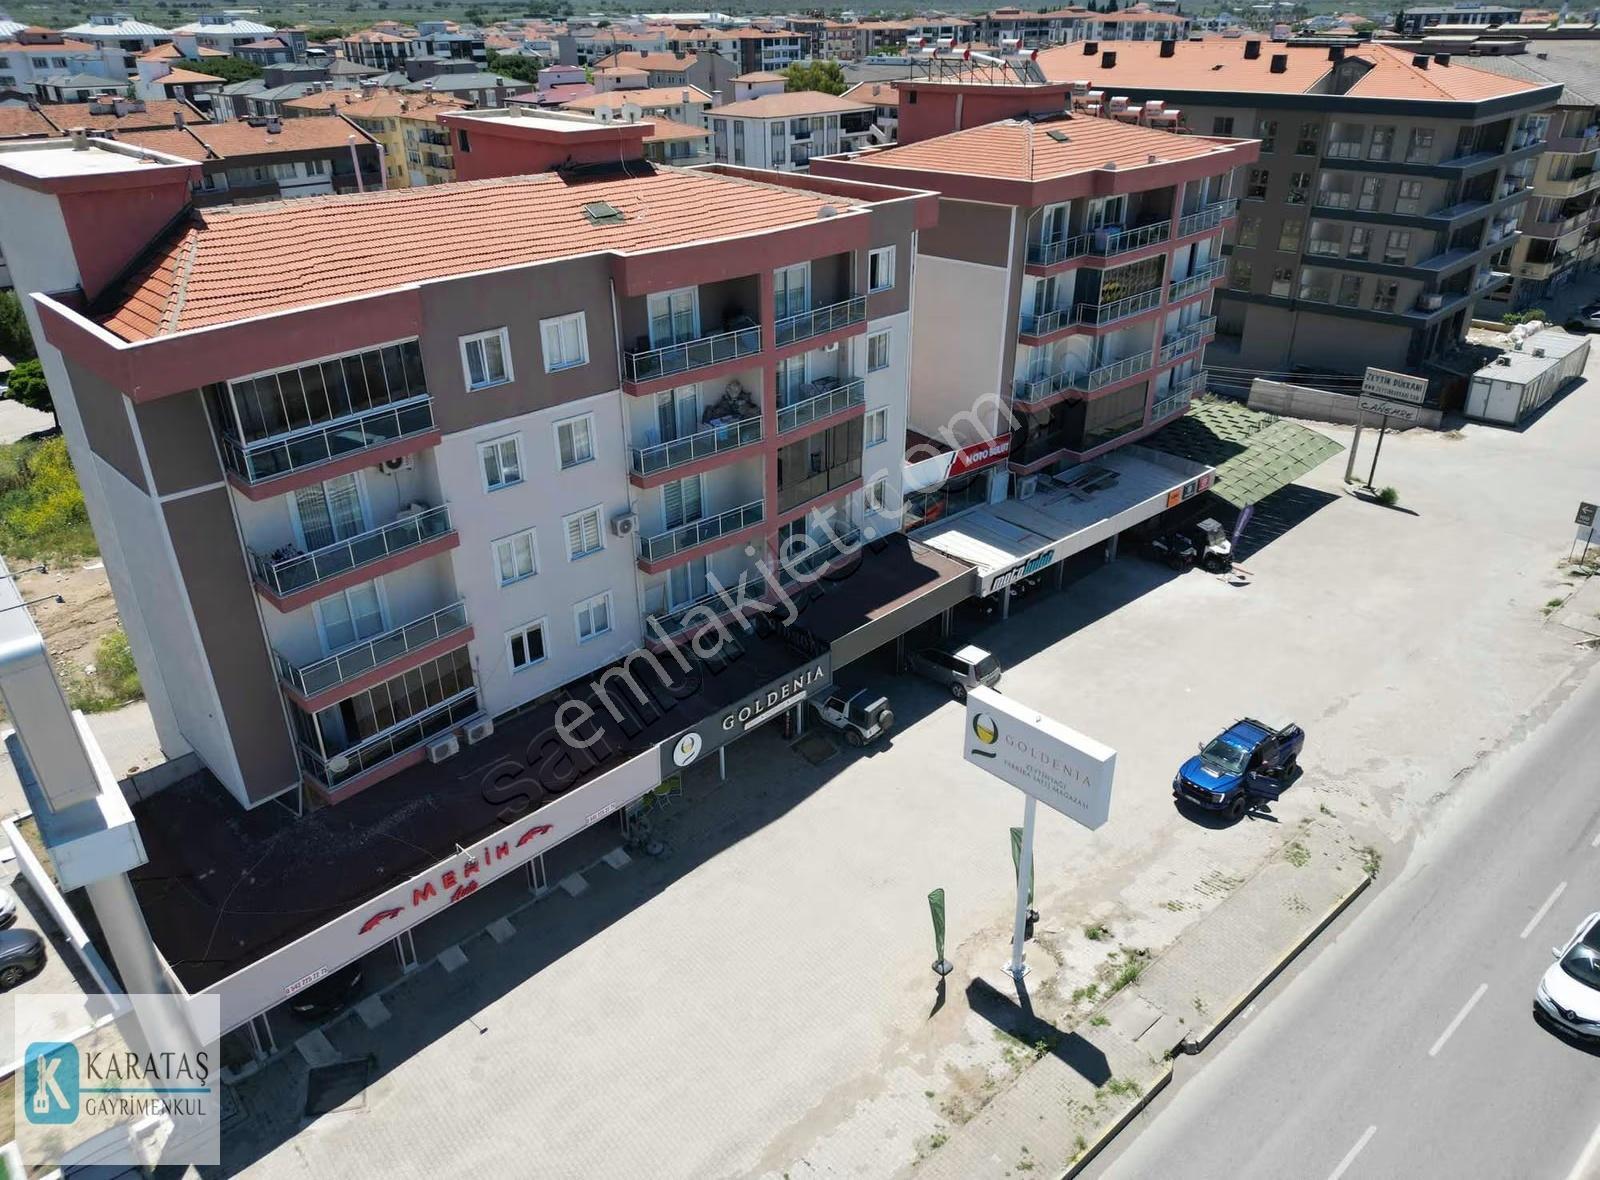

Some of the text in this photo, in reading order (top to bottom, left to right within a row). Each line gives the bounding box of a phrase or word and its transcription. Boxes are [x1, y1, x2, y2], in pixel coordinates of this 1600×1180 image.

[723, 665, 825, 731] GOLDENIA
[1005, 734, 1092, 787] GOLDENIA
[412, 841, 510, 907] MERİH
